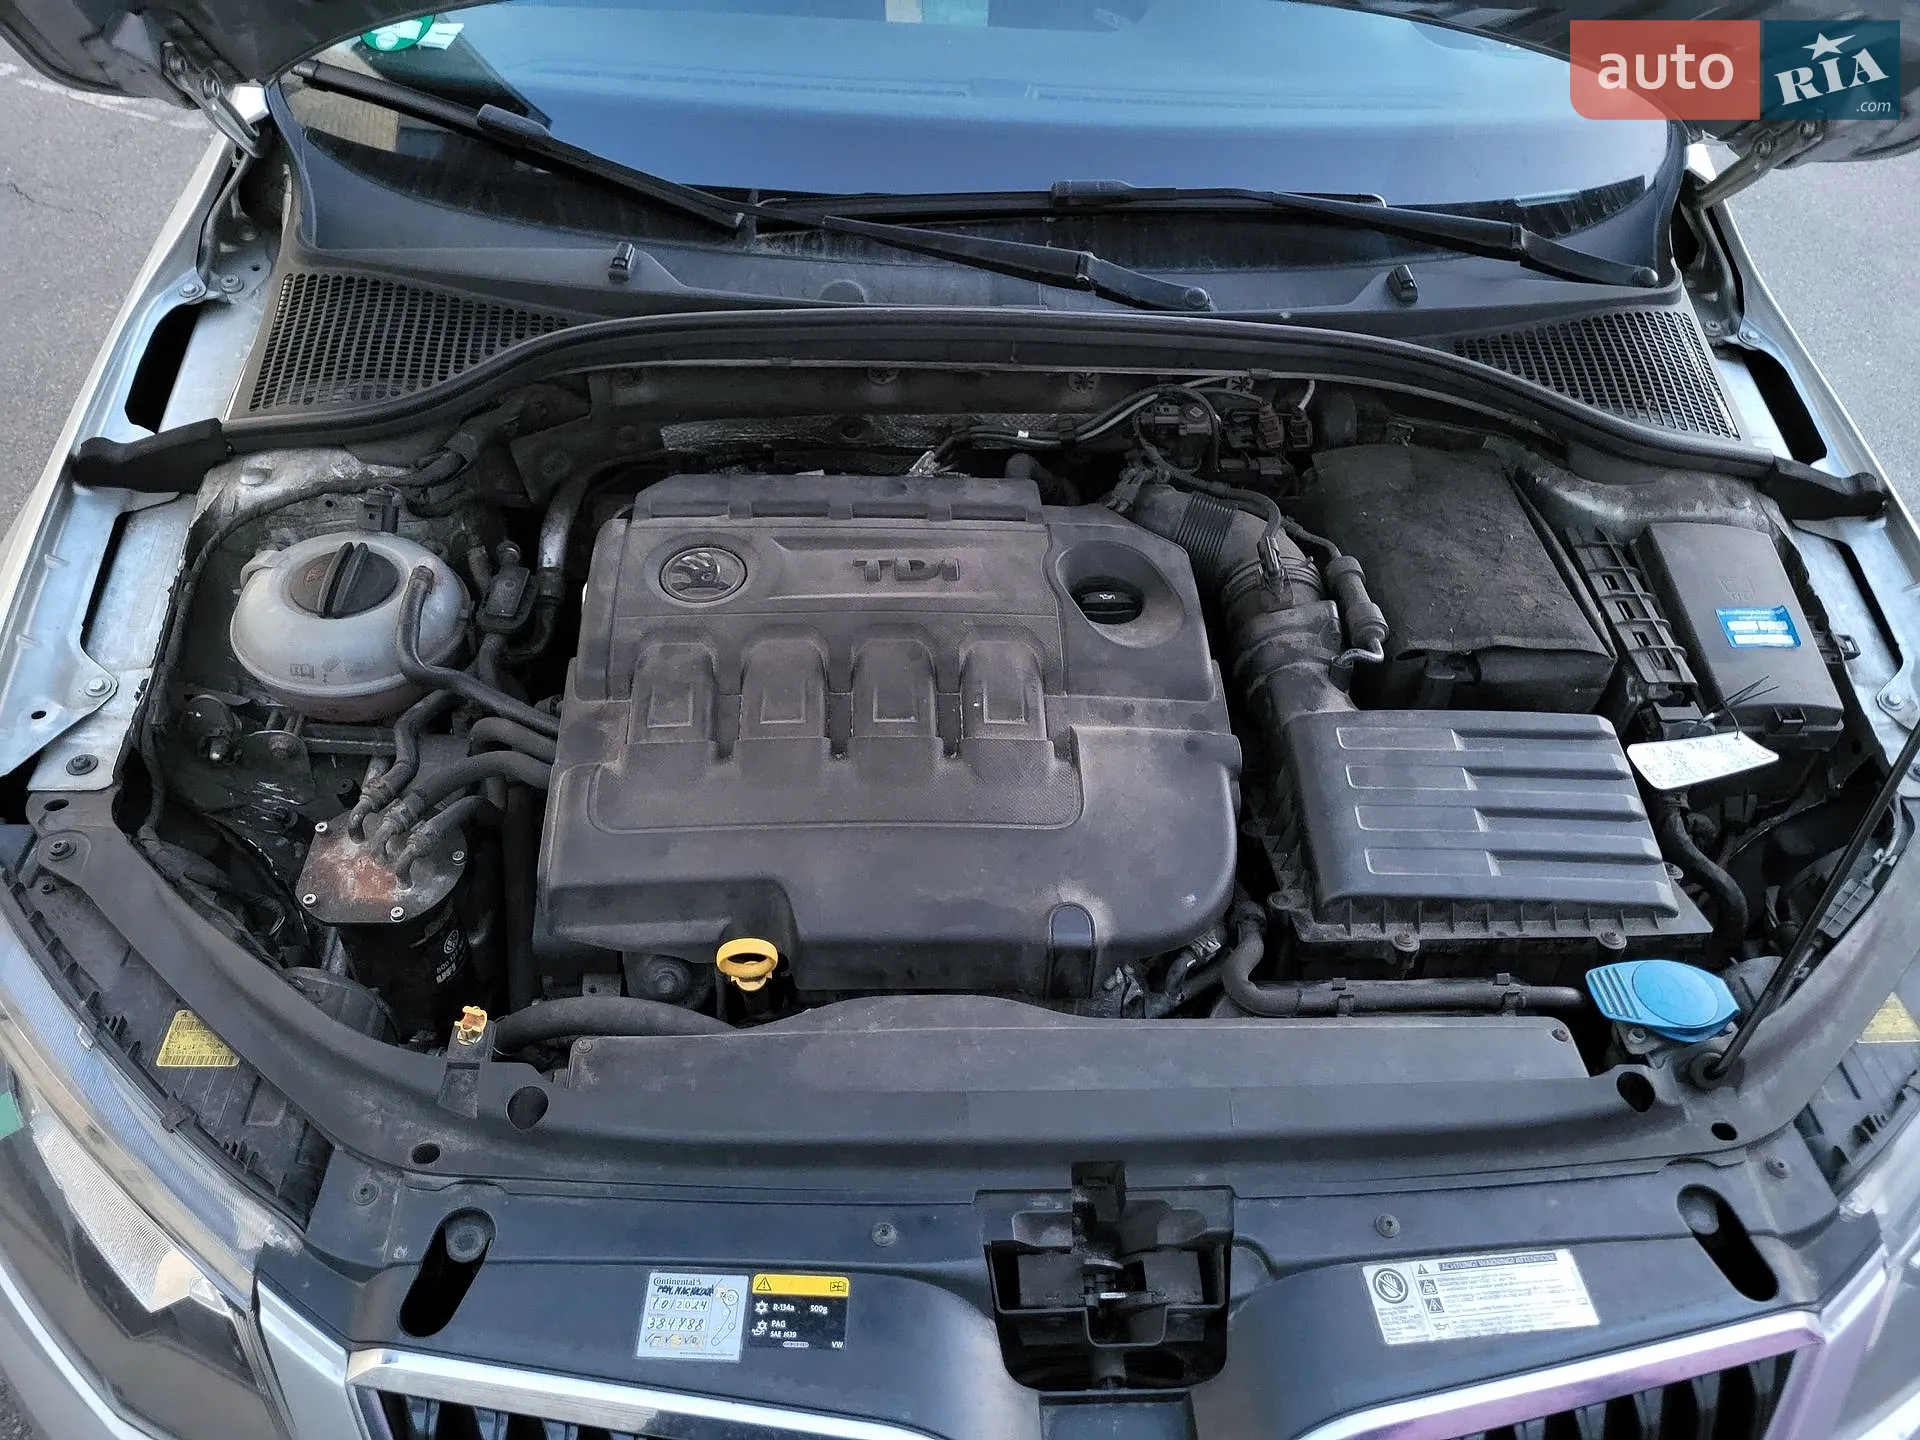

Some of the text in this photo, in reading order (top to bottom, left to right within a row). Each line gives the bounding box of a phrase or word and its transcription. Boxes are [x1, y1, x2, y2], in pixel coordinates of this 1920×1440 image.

[852, 558, 961, 582] TDI
[773, 1303, 795, 1312] R-134a
[771, 1320, 786, 1328] PAG
[770, 1330, 782, 1338] SAE
